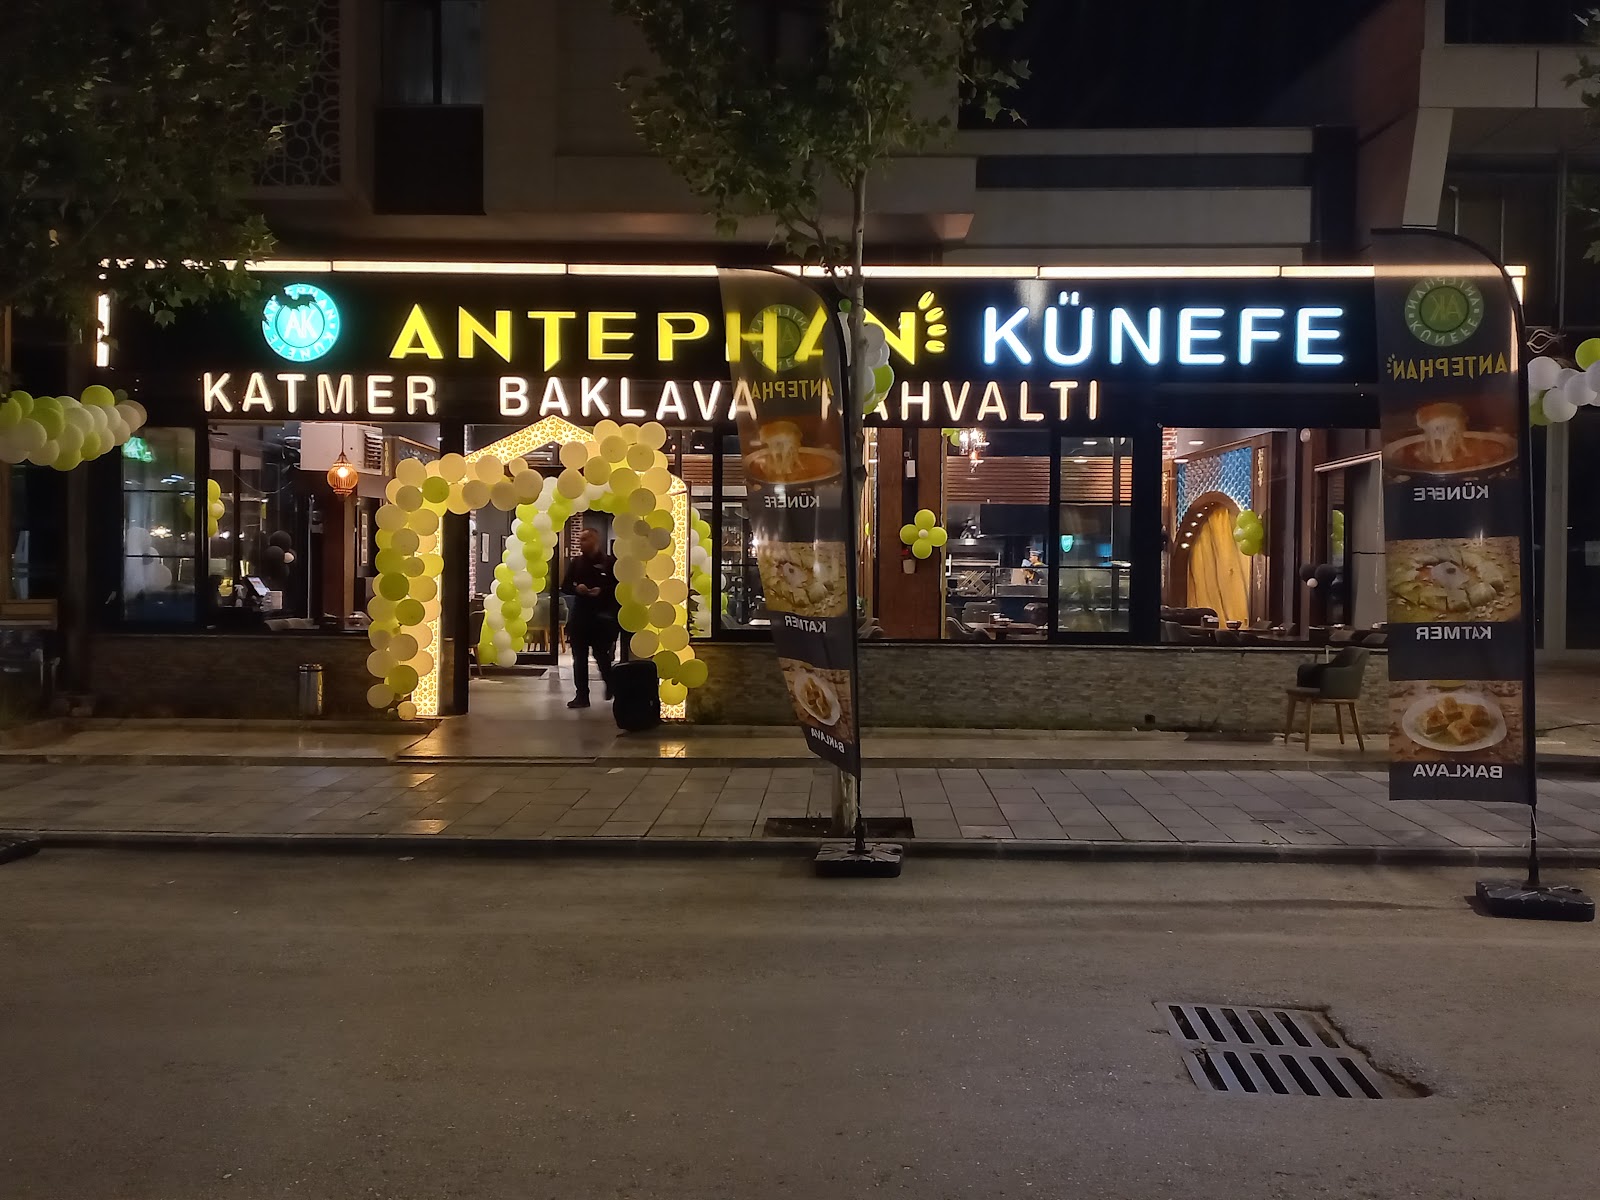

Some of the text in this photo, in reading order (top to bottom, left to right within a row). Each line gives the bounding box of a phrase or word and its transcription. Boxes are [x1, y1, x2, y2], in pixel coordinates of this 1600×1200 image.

[283, 308, 319, 339] AK
[981, 290, 1345, 367] KÜNEFE
[202, 371, 439, 416] KATMER
[499, 375, 758, 421] BAKLAVA
